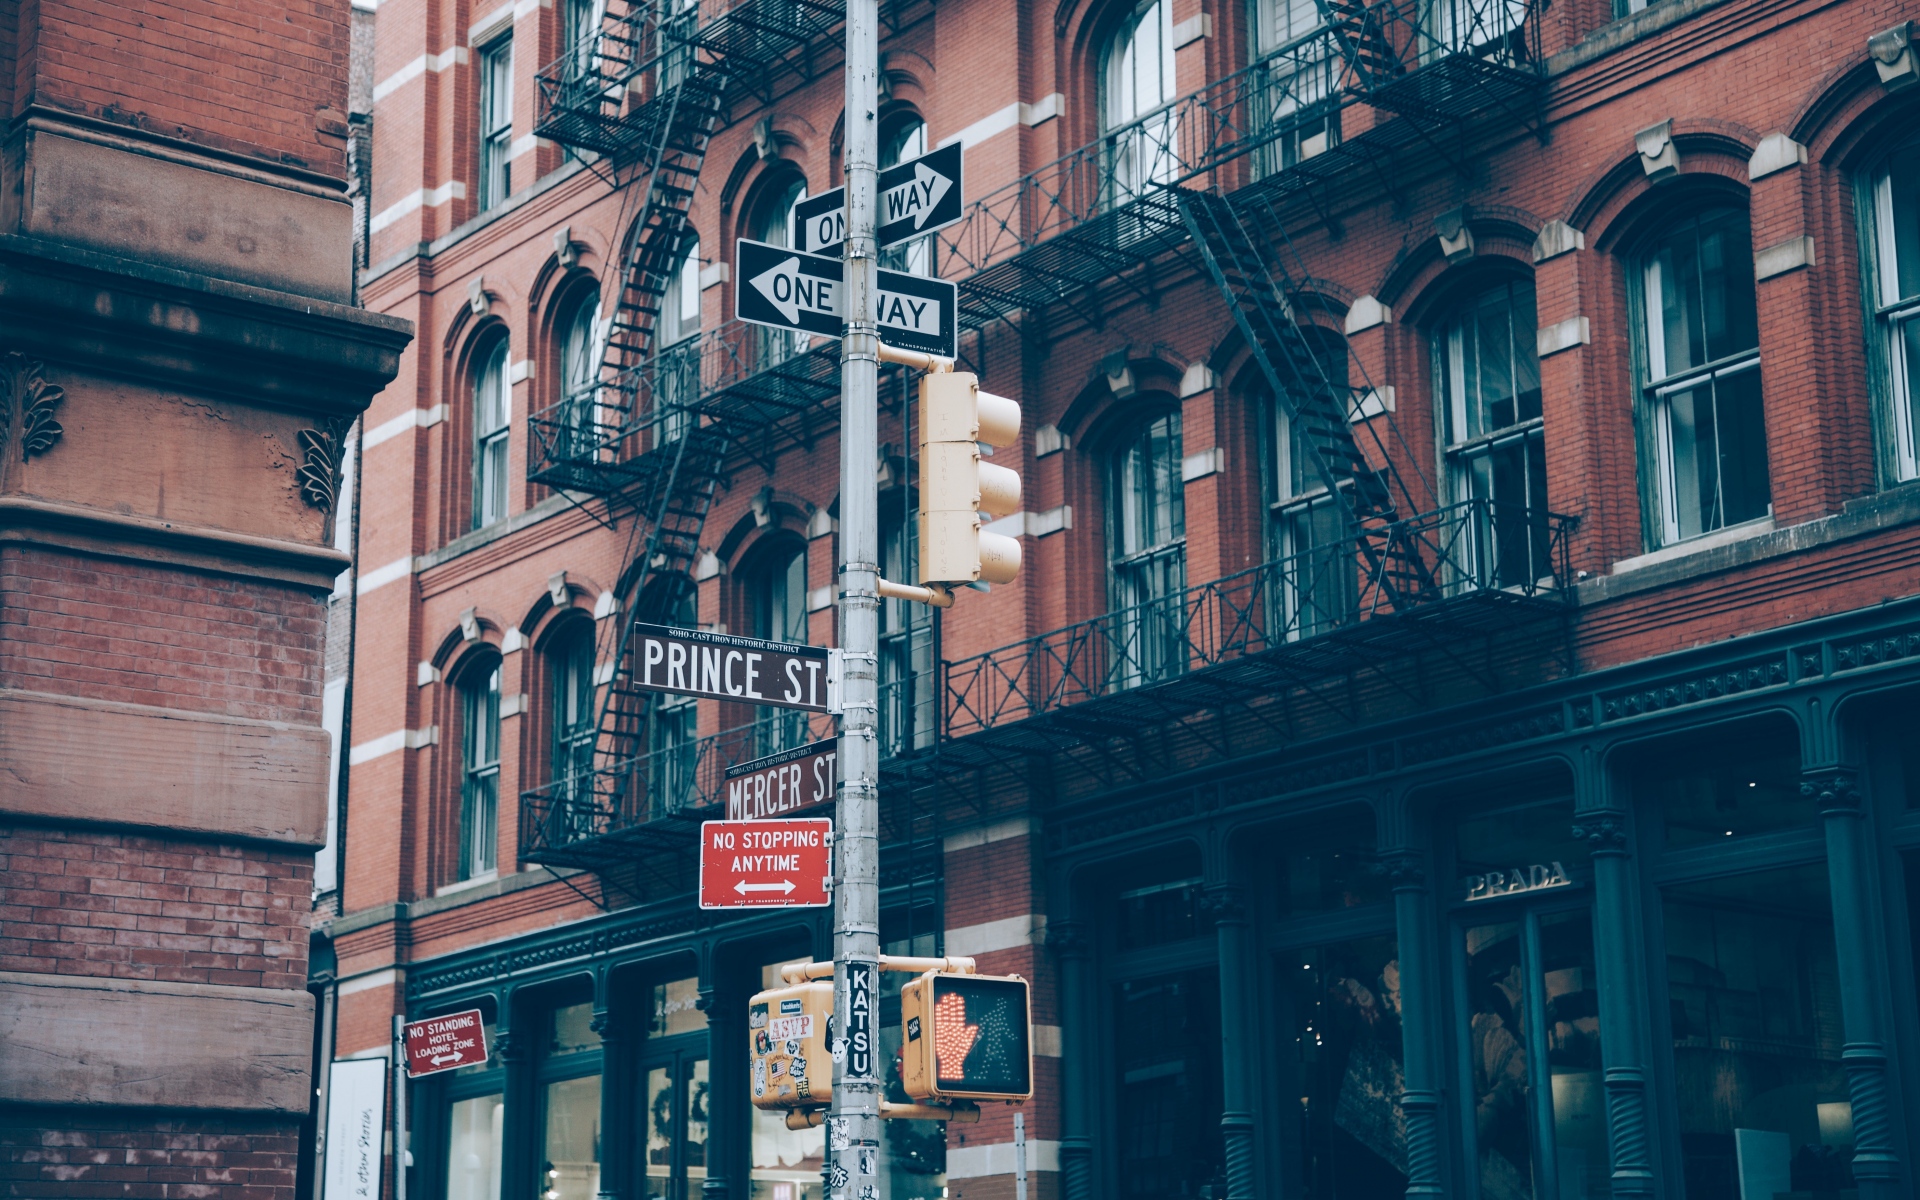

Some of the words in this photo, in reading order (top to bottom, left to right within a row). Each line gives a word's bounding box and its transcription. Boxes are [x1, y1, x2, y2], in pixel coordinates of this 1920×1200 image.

[819, 211, 845, 245] ON
[887, 175, 937, 221] WAY
[772, 272, 833, 312] ONE
[897, 341, 946, 354] TRANSPORTATION
[712, 635, 730, 644] IRON
[731, 638, 766, 649] HISTORIC
[767, 642, 800, 654] DISTRICT
[644, 639, 763, 699] PRINCE
[784, 658, 822, 706] ST
[729, 763, 802, 820] MERCER
[813, 753, 836, 802] ST
[713, 832, 735, 849] NO
[742, 830, 819, 849] STOPPING
[731, 854, 800, 873] ANYTIME
[1465, 861, 1571, 901] PRADA
[409, 1026, 424, 1039] NO
[427, 1016, 474, 1035] STANDING
[770, 1016, 810, 1040] ASVP
[853, 970, 869, 1073] KATSU
[414, 1044, 451, 1059] LOADING
[452, 1038, 476, 1051] ZONE
[428, 1032, 459, 1045] HOTEL
